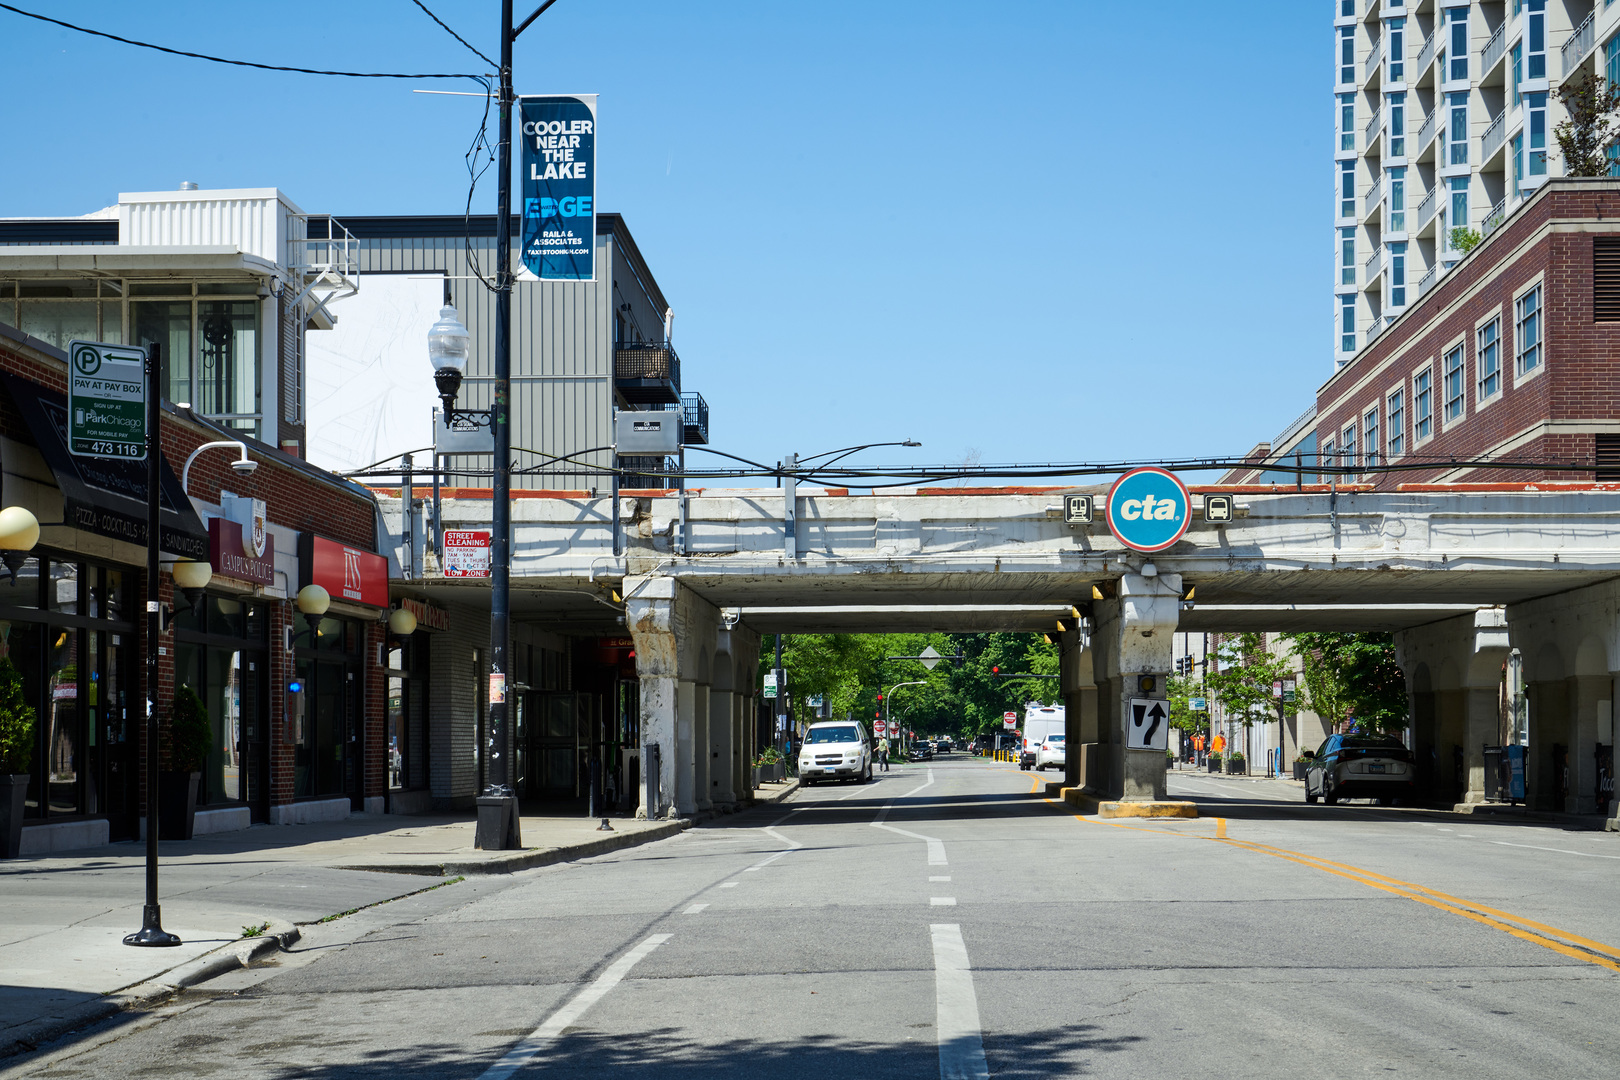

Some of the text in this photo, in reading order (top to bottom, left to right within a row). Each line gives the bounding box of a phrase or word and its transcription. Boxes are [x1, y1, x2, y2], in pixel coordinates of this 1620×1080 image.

[523, 120, 593, 136] COOLER
[536, 135, 580, 150] NEAR
[542, 149, 574, 163] THE
[531, 162, 586, 180] LAKE
[525, 196, 592, 219] EDGE
[534, 238, 582, 246] ASSOCIATES
[75, 380, 91, 388] PAY
[105, 383, 120, 391] PAY
[123, 385, 141, 393] BOX
[86, 413, 141, 428] ParkChicago
[91, 442, 113, 454] 473
[117, 444, 138, 456] 116
[1120, 494, 1177, 521] cta
[75, 506, 97, 527] PIZZA
[101, 514, 138, 539] COCKTAILS
[166, 532, 204, 556] SANDWICHES
[221, 551, 272, 581] CAMPUS POLICE
